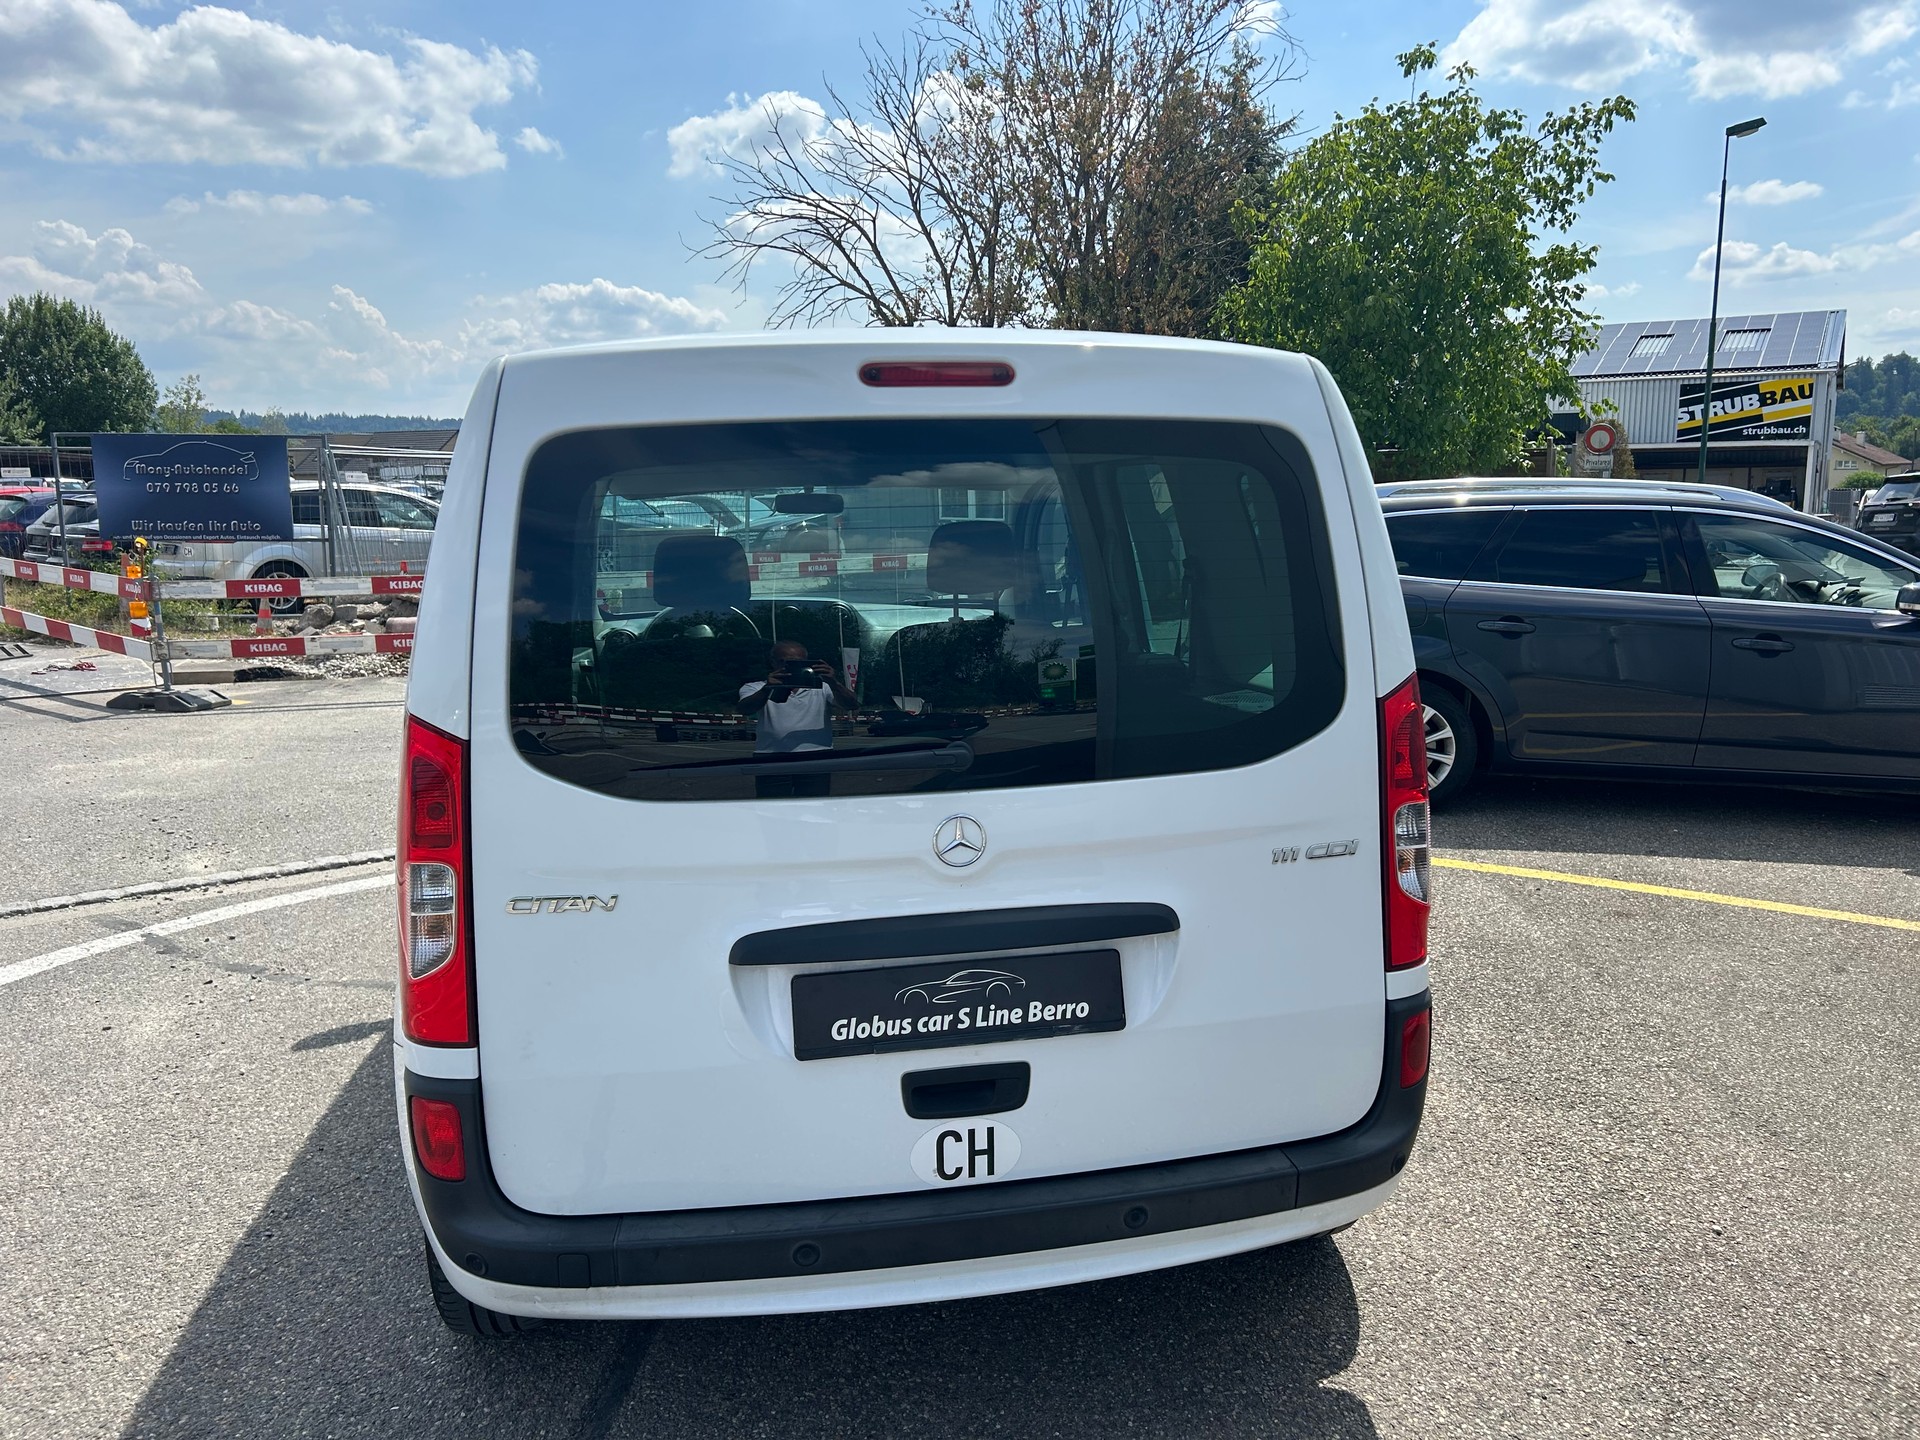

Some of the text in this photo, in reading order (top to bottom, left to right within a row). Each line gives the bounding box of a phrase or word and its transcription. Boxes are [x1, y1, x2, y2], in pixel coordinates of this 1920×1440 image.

[1677, 382, 1814, 424] STRUBBAU
[1743, 425, 1806, 436] strubbau.ch
[135, 464, 248, 477] Mony-Autohandel
[146, 483, 239, 493] 079 798 05 66
[131, 520, 261, 531] Wir kaufen Ihr Auto
[183, 547, 192, 556] CH
[20, 566, 33, 576] KIBAG
[69, 574, 84, 583] KIBAG
[244, 583, 283, 593] KIBAG
[250, 643, 287, 653] KIBAG
[393, 638, 413, 648] KIB
[1271, 838, 1359, 865] 111 CDI
[505, 894, 619, 914] CITAN
[831, 1001, 1090, 1041] Globus car S Line Berro
[936, 1126, 995, 1181] CH
